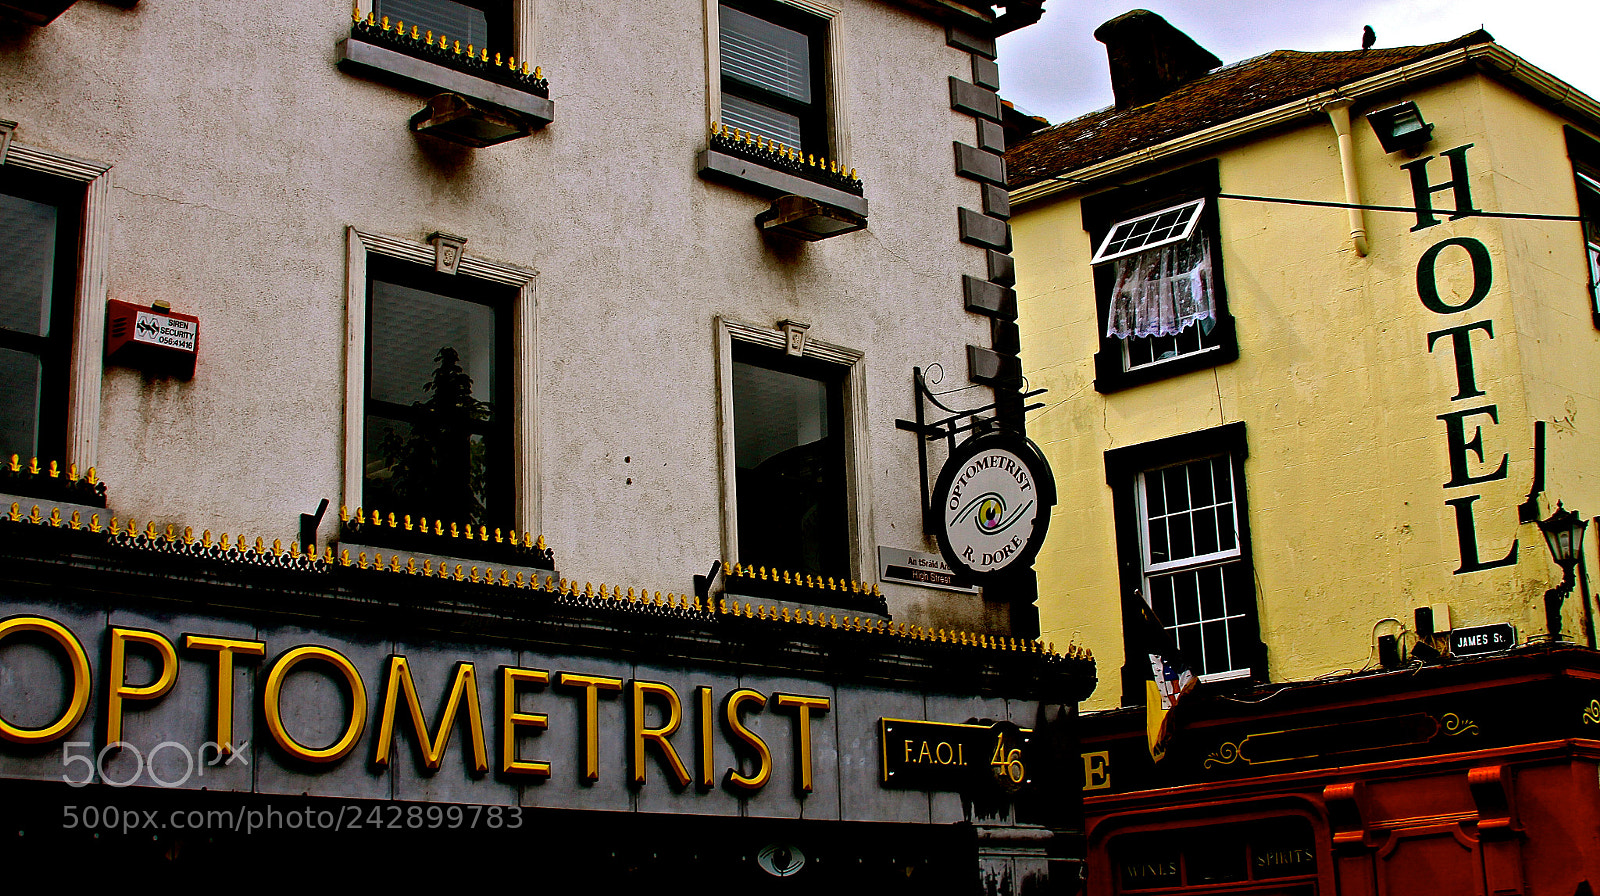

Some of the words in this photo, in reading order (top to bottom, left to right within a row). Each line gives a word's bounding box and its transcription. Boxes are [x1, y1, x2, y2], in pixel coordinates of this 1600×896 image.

[160, 327, 194, 340] SECURITY
[168, 319, 189, 329] SIREN
[1400, 143, 1519, 576] HOTEL
[949, 455, 1031, 511] OPTOMETRIST
[907, 556, 917, 566] An
[962, 545, 975, 563] R.
[981, 534, 1023, 566] DORE
[912, 570, 929, 582] High
[930, 572, 951, 584] Street
[1457, 633, 1489, 648] JAMES
[0, 616, 831, 793] OPTOMETRIST
[904, 739, 968, 766] F.A.O.I.
[990, 732, 1025, 783] 46
[1256, 848, 1313, 867] SPIRITS
